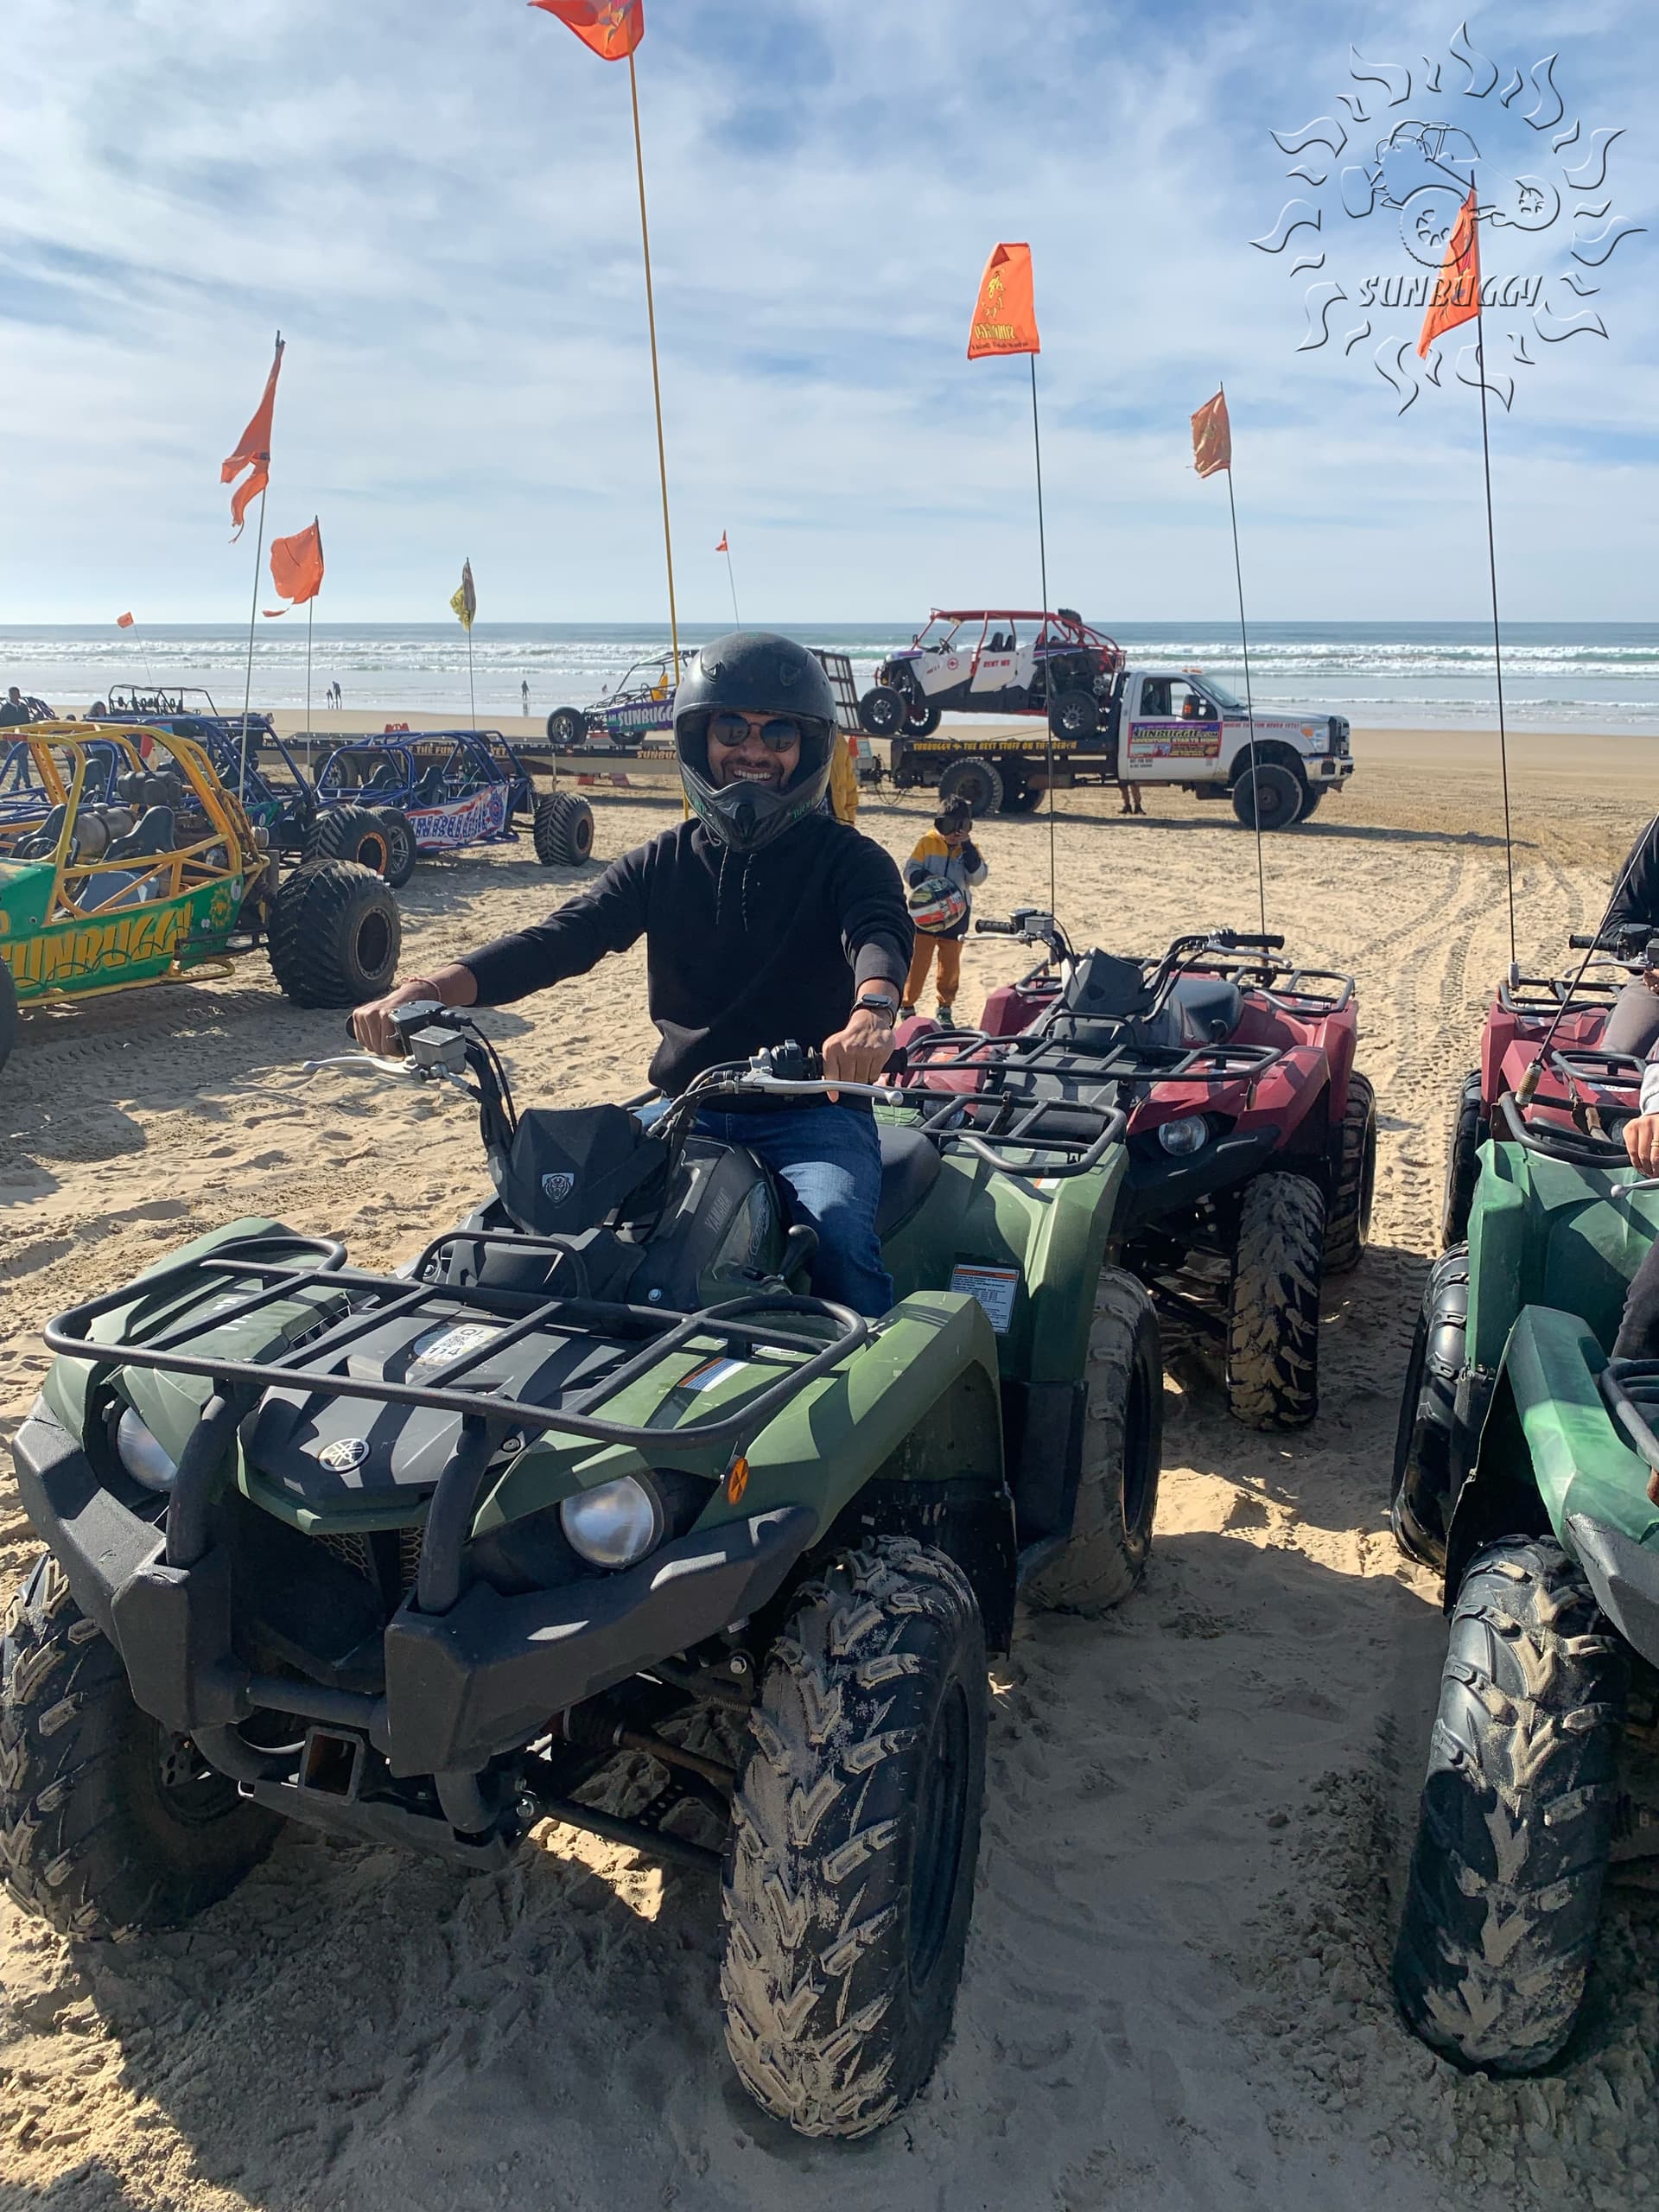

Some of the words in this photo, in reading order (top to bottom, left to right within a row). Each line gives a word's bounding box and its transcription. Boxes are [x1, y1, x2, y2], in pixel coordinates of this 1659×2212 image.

[618, 704, 674, 727] SUNBUGG
[963, 741, 977, 750] THE
[979, 741, 997, 750] BEST
[999, 741, 1020, 750] STUFF
[637, 750, 677, 760] SUNBUG
